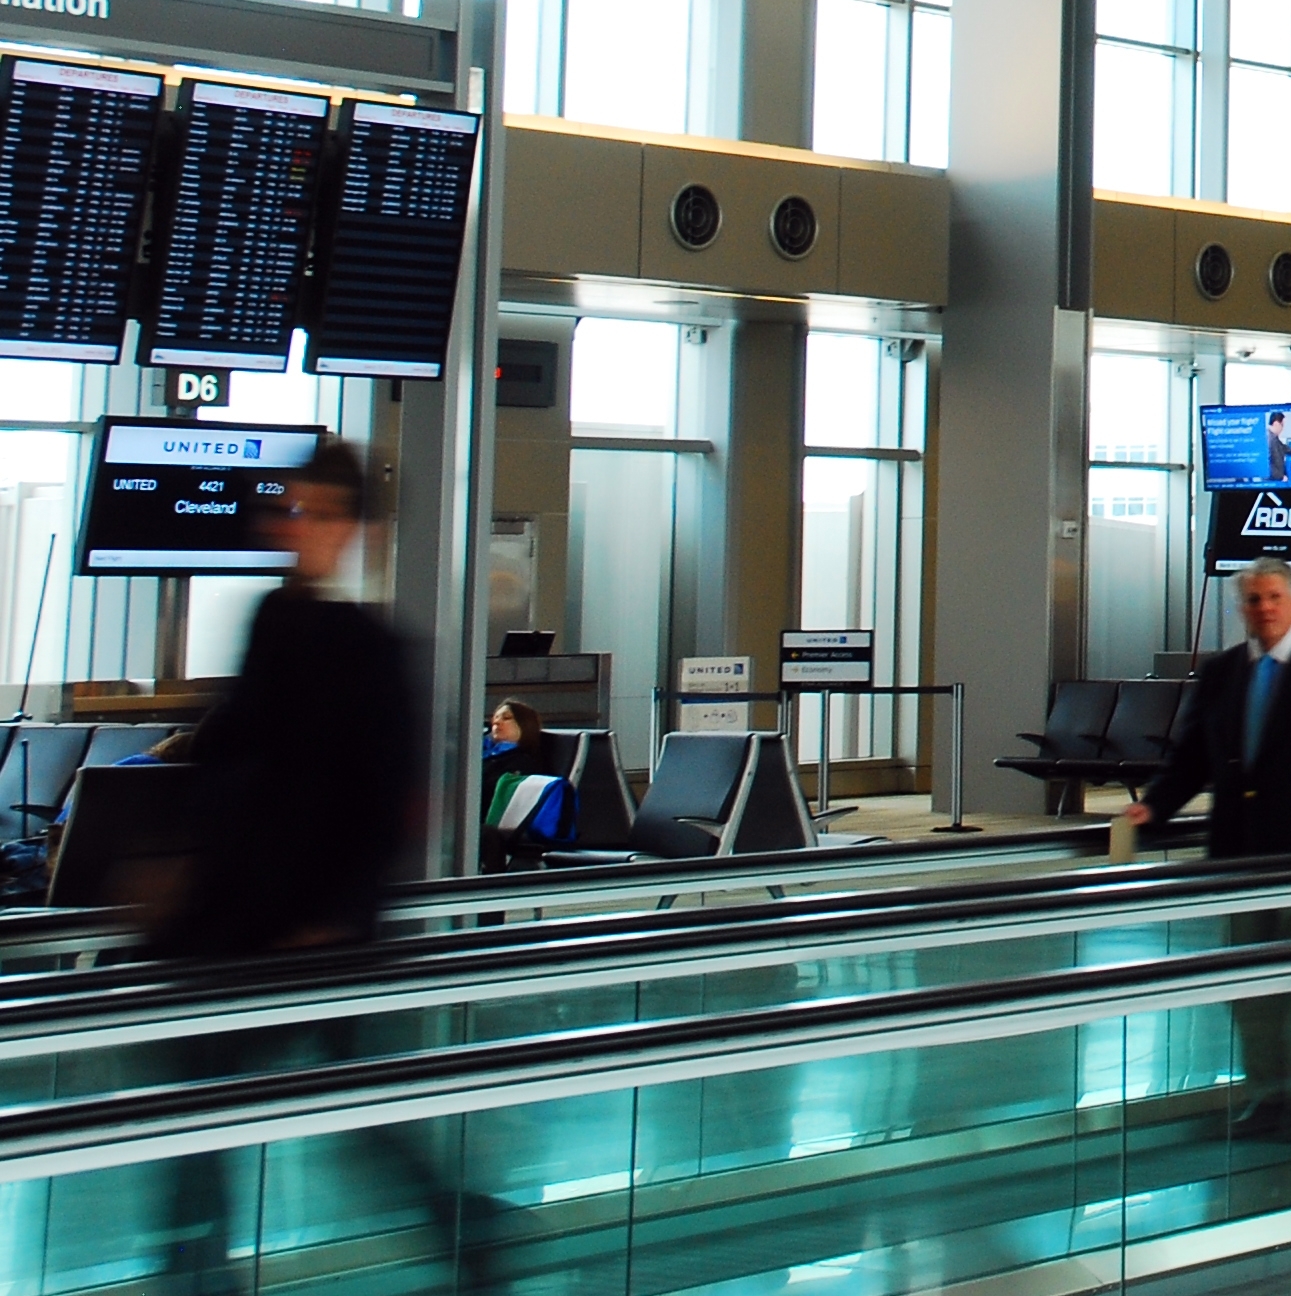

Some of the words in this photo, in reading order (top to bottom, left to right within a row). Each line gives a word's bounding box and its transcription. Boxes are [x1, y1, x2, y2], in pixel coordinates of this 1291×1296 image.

[59, 67, 119, 83] DEPARTURES
[234, 90, 289, 104] DEPARTURES
[178, 372, 219, 402] D6
[163, 441, 239, 455] UNITED
[112, 478, 158, 491] UNITED
[198, 480, 225, 492] 4421
[174, 499, 238, 515] Cleveland
[688, 666, 732, 675] UNITED
